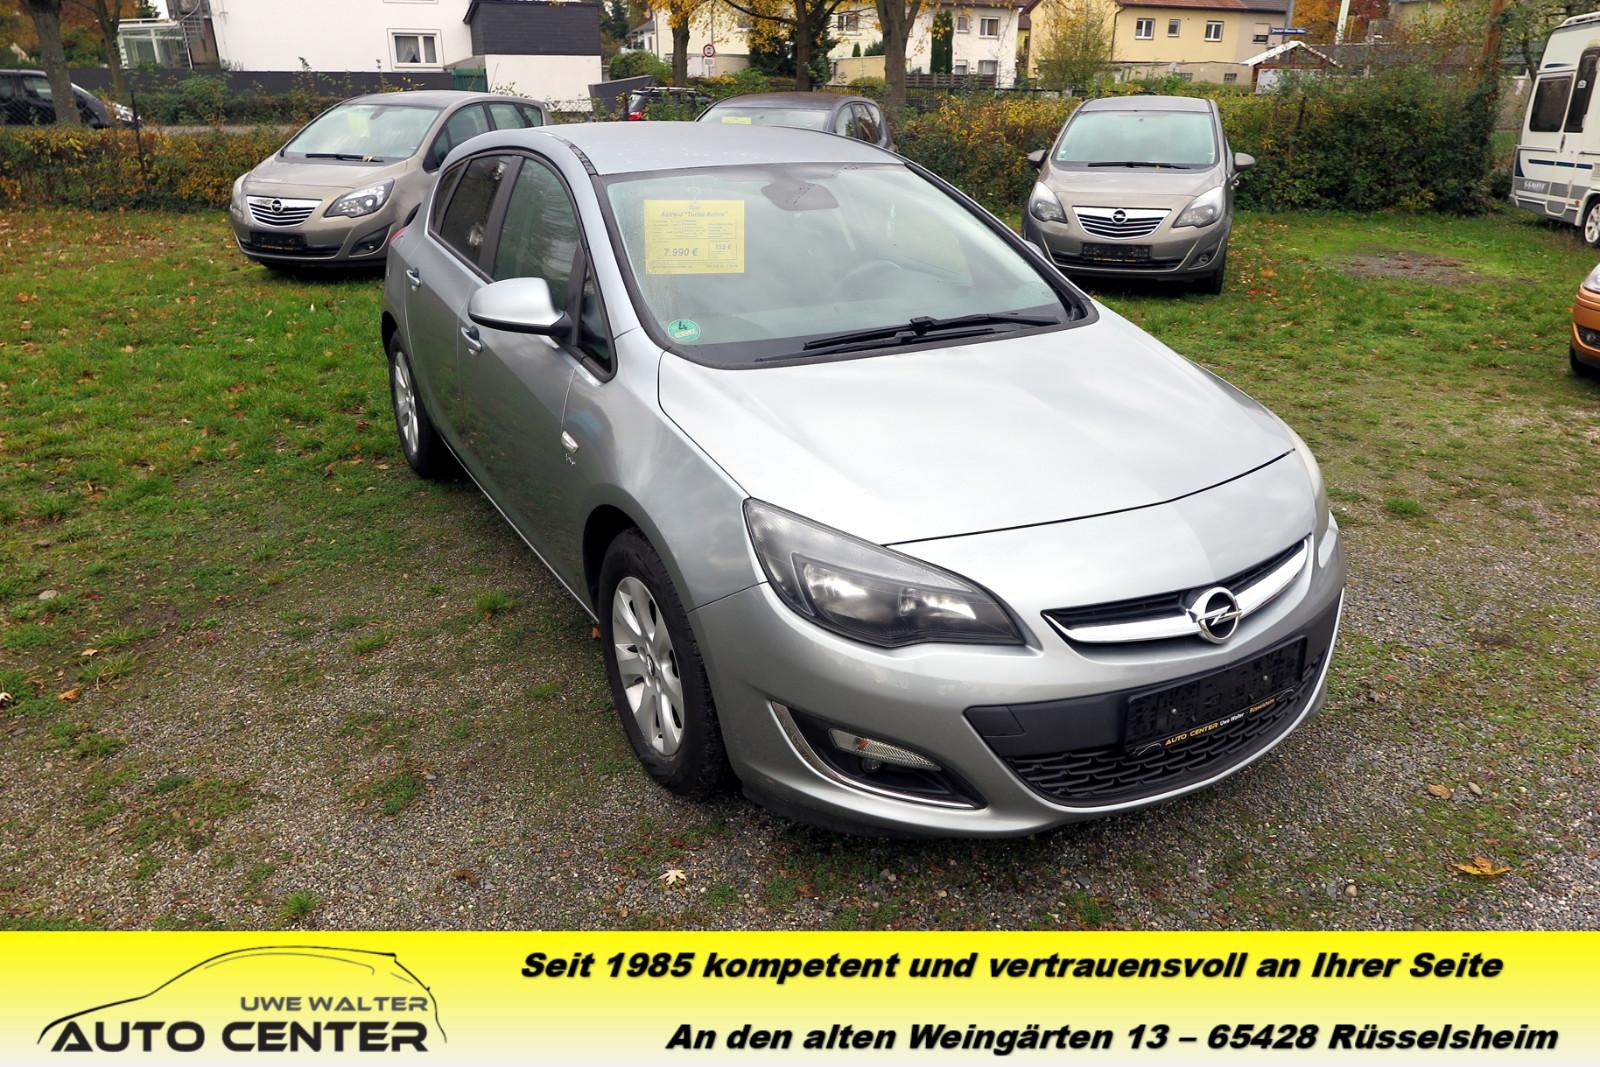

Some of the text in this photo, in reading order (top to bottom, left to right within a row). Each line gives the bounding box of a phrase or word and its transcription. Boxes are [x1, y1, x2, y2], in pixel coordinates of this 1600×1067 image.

[663, 247, 699, 257] 7.990 €
[678, 320, 688, 330] 4
[1165, 734, 1187, 746] AUTO
[1189, 723, 1218, 736] CENTER
